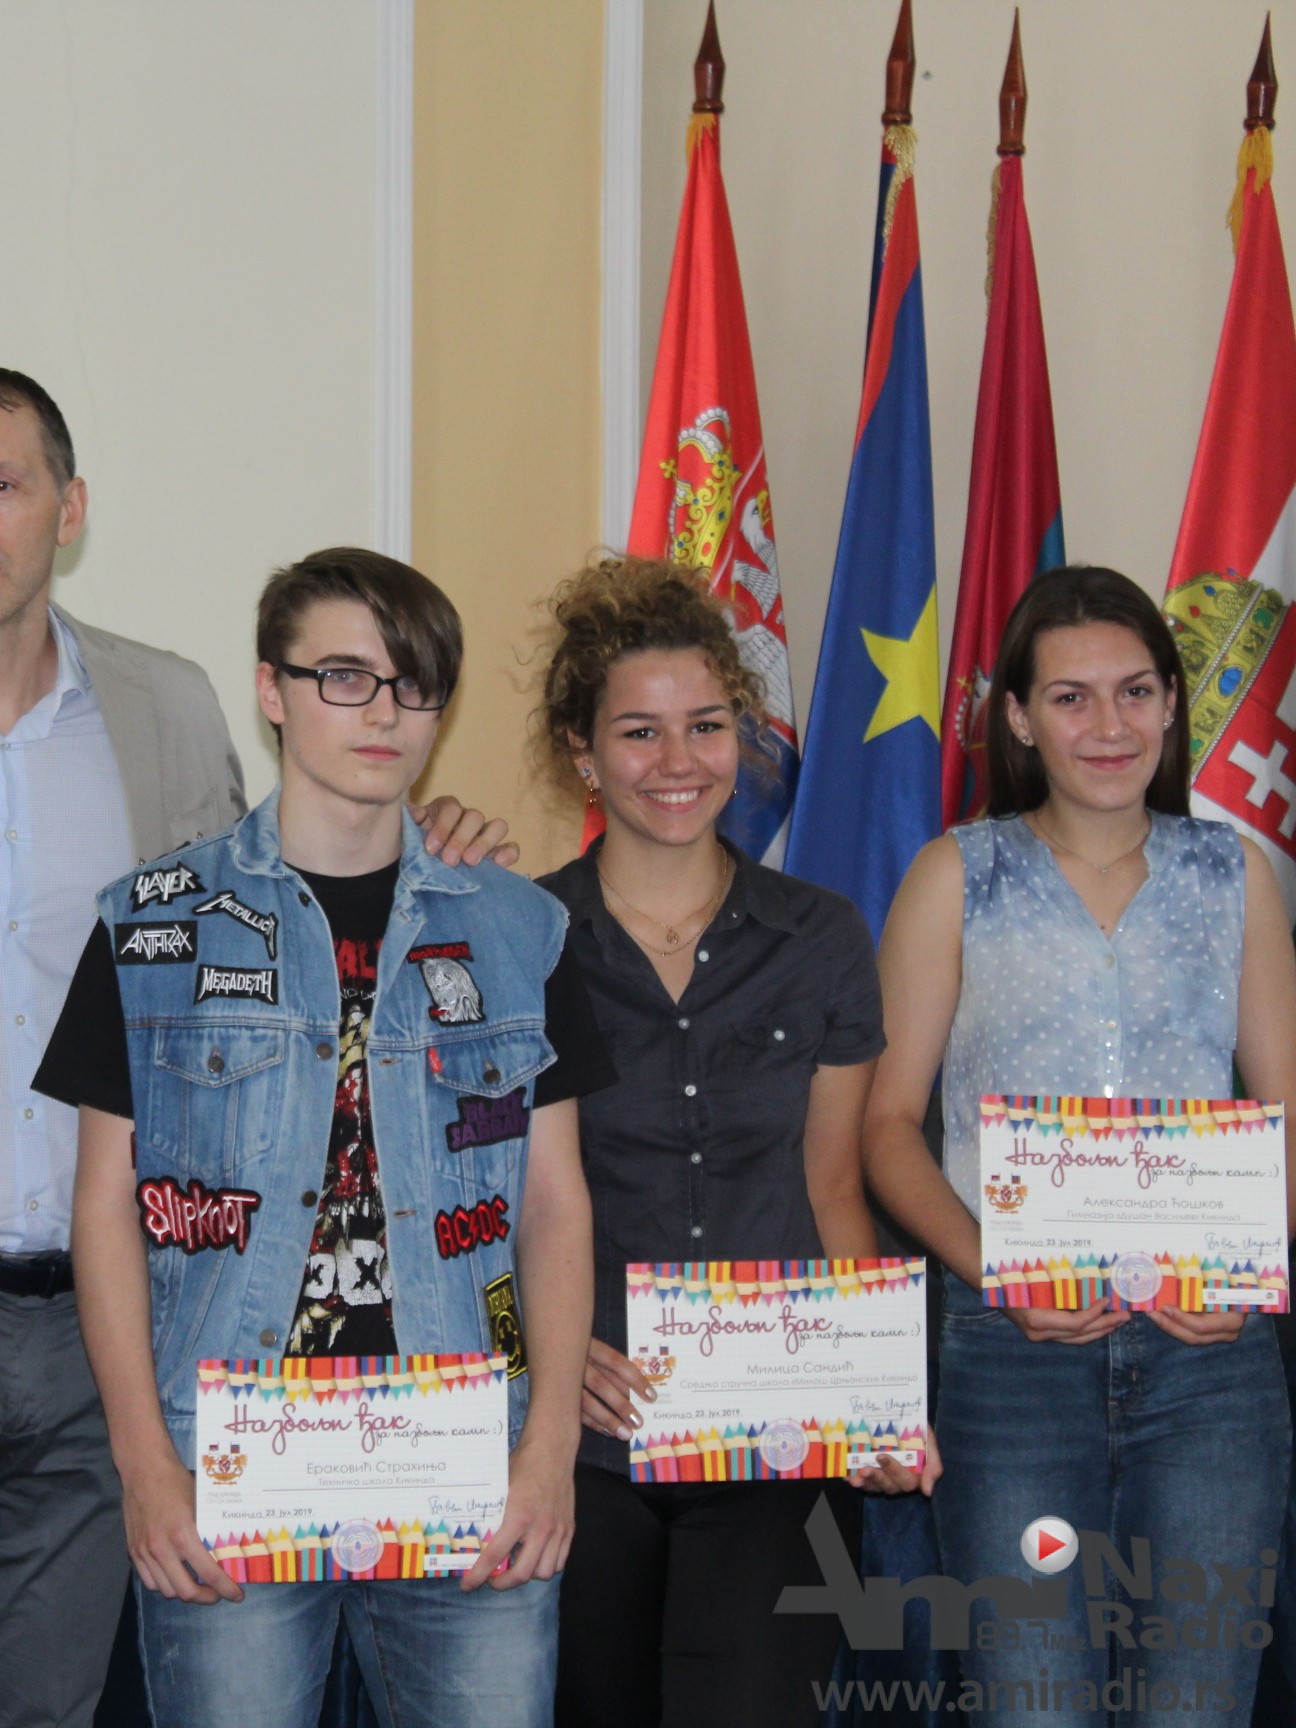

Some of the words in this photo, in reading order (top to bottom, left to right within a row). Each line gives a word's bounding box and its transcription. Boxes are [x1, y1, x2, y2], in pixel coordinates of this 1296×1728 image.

[134, 867, 196, 904] SLAYER
[121, 925, 193, 960] ANTHRAX
[195, 893, 275, 958] METALLICA
[197, 967, 274, 1002] MEGADETH
[1083, 1196, 1167, 1211] Александра
[747, 1363, 800, 1376] Милица
[803, 1360, 854, 1375] Сандић
[307, 1461, 372, 1478] Ераковић
[376, 1460, 447, 1476] Страхиња
